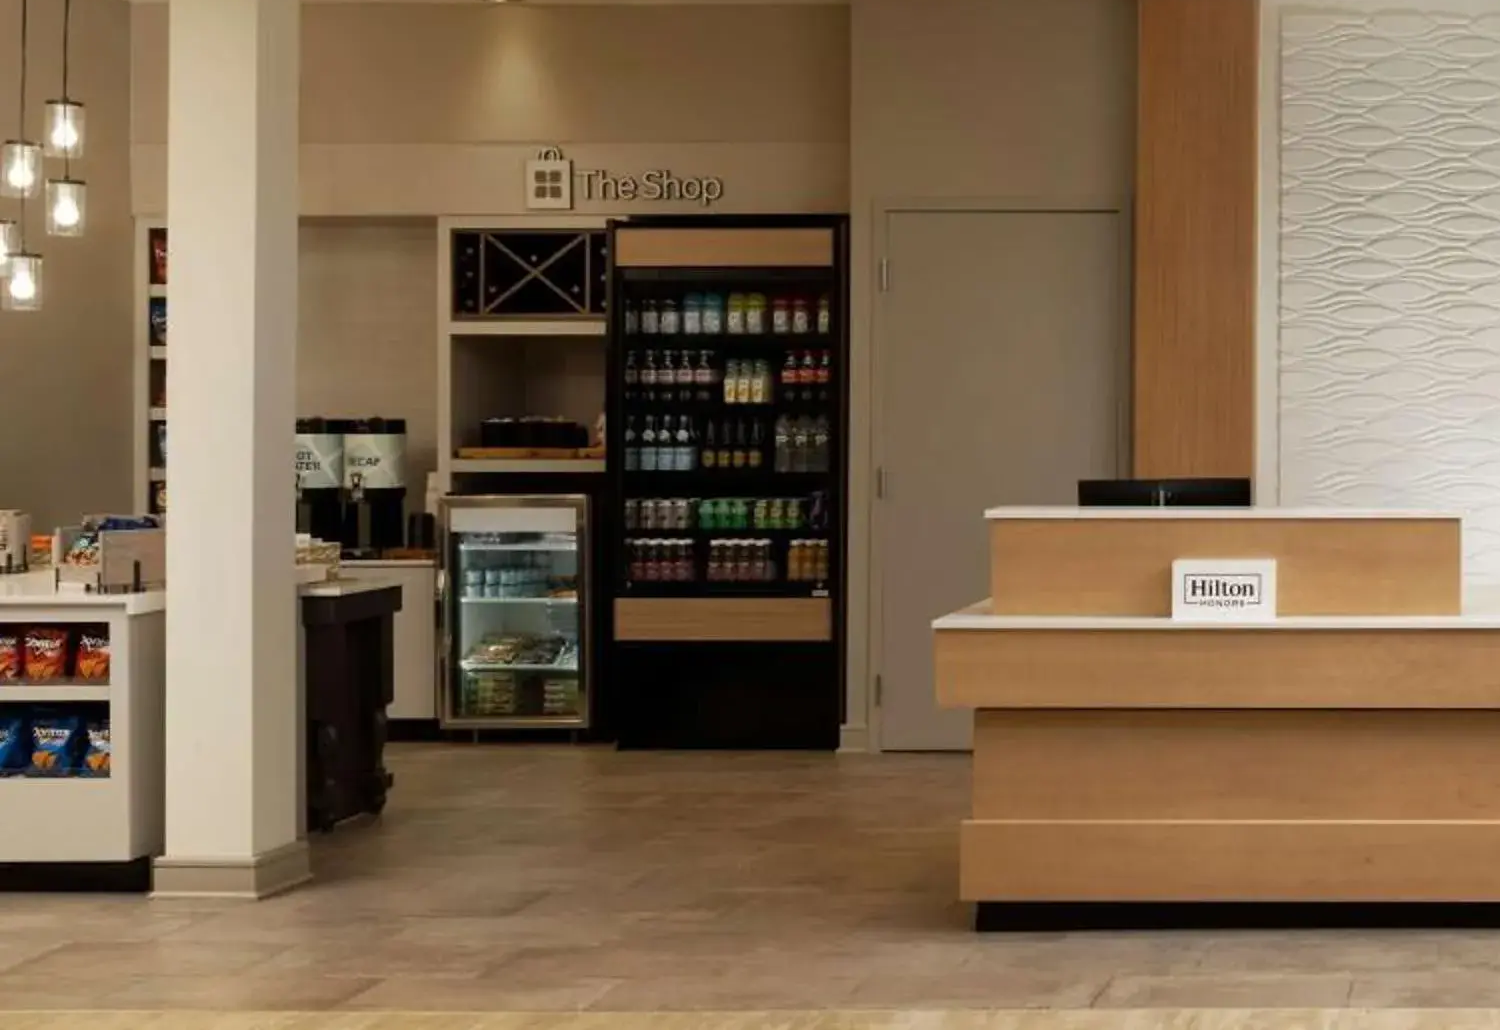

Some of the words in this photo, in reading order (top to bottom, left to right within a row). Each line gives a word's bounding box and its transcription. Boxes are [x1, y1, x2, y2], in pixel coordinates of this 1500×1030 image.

[577, 169, 637, 200] The
[641, 169, 723, 206] Shop
[1191, 579, 1254, 597] Hilton
